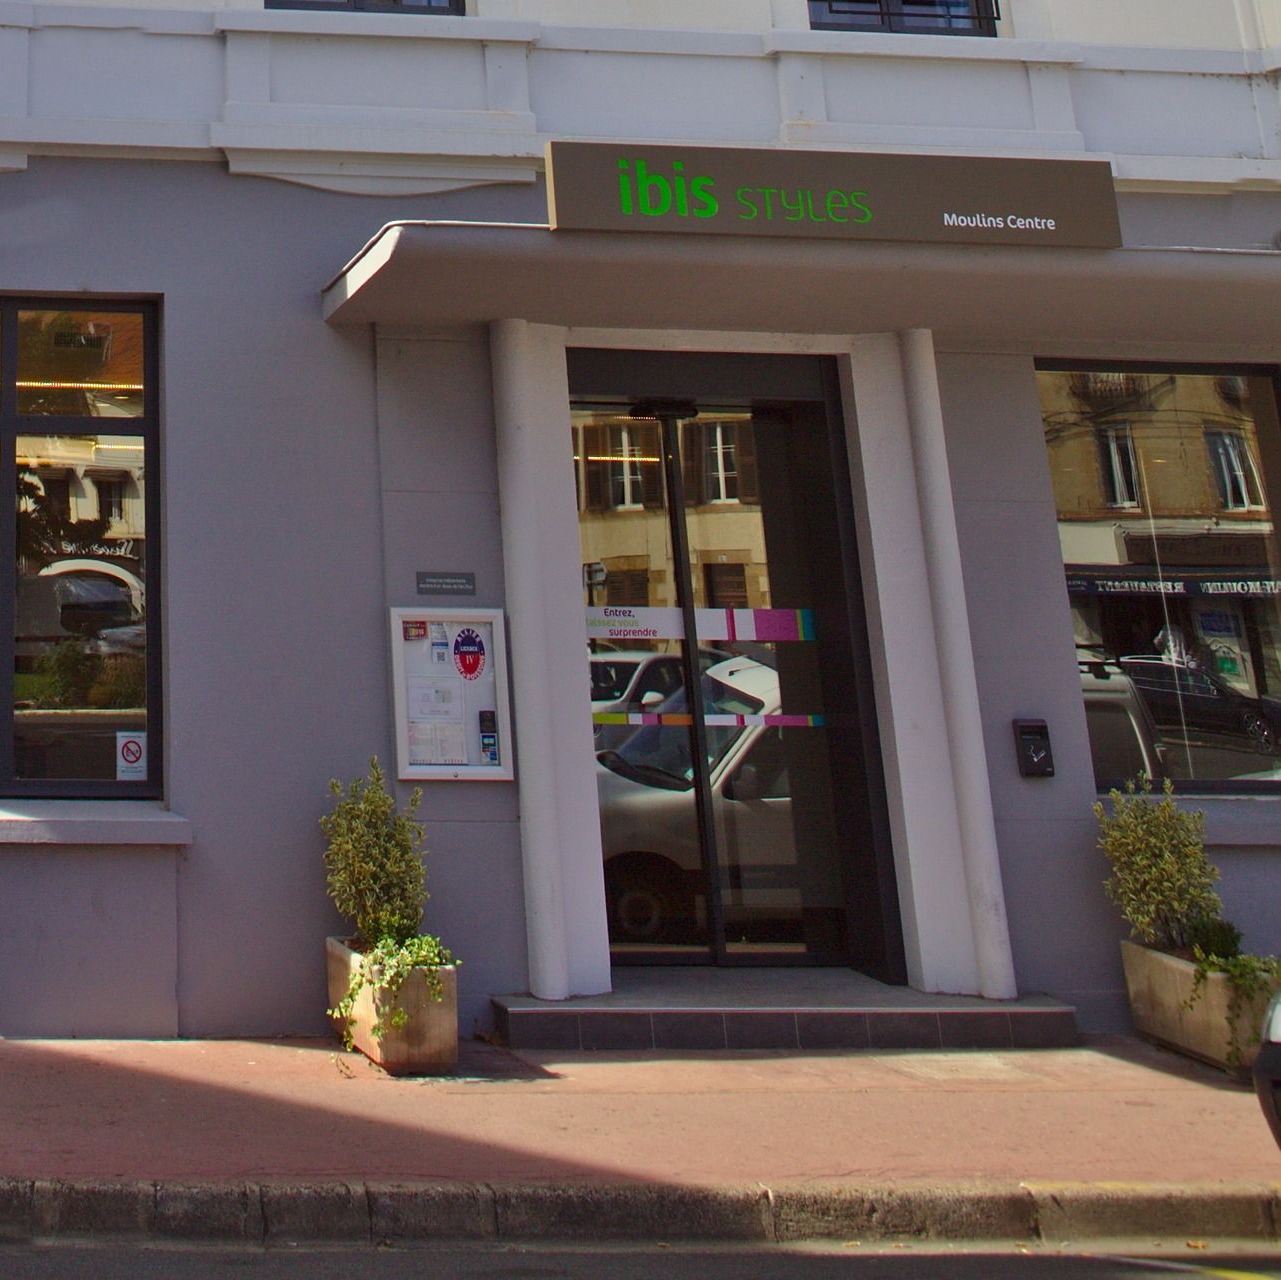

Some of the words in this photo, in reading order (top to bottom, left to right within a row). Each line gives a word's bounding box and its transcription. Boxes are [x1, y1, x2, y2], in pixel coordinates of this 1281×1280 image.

[618, 159, 718, 218] ibis
[943, 213, 1005, 228] Moulins
[1006, 215, 1056, 230] Centre
[604, 608, 635, 618] Entrez,
[609, 628, 658, 638] surprendre
